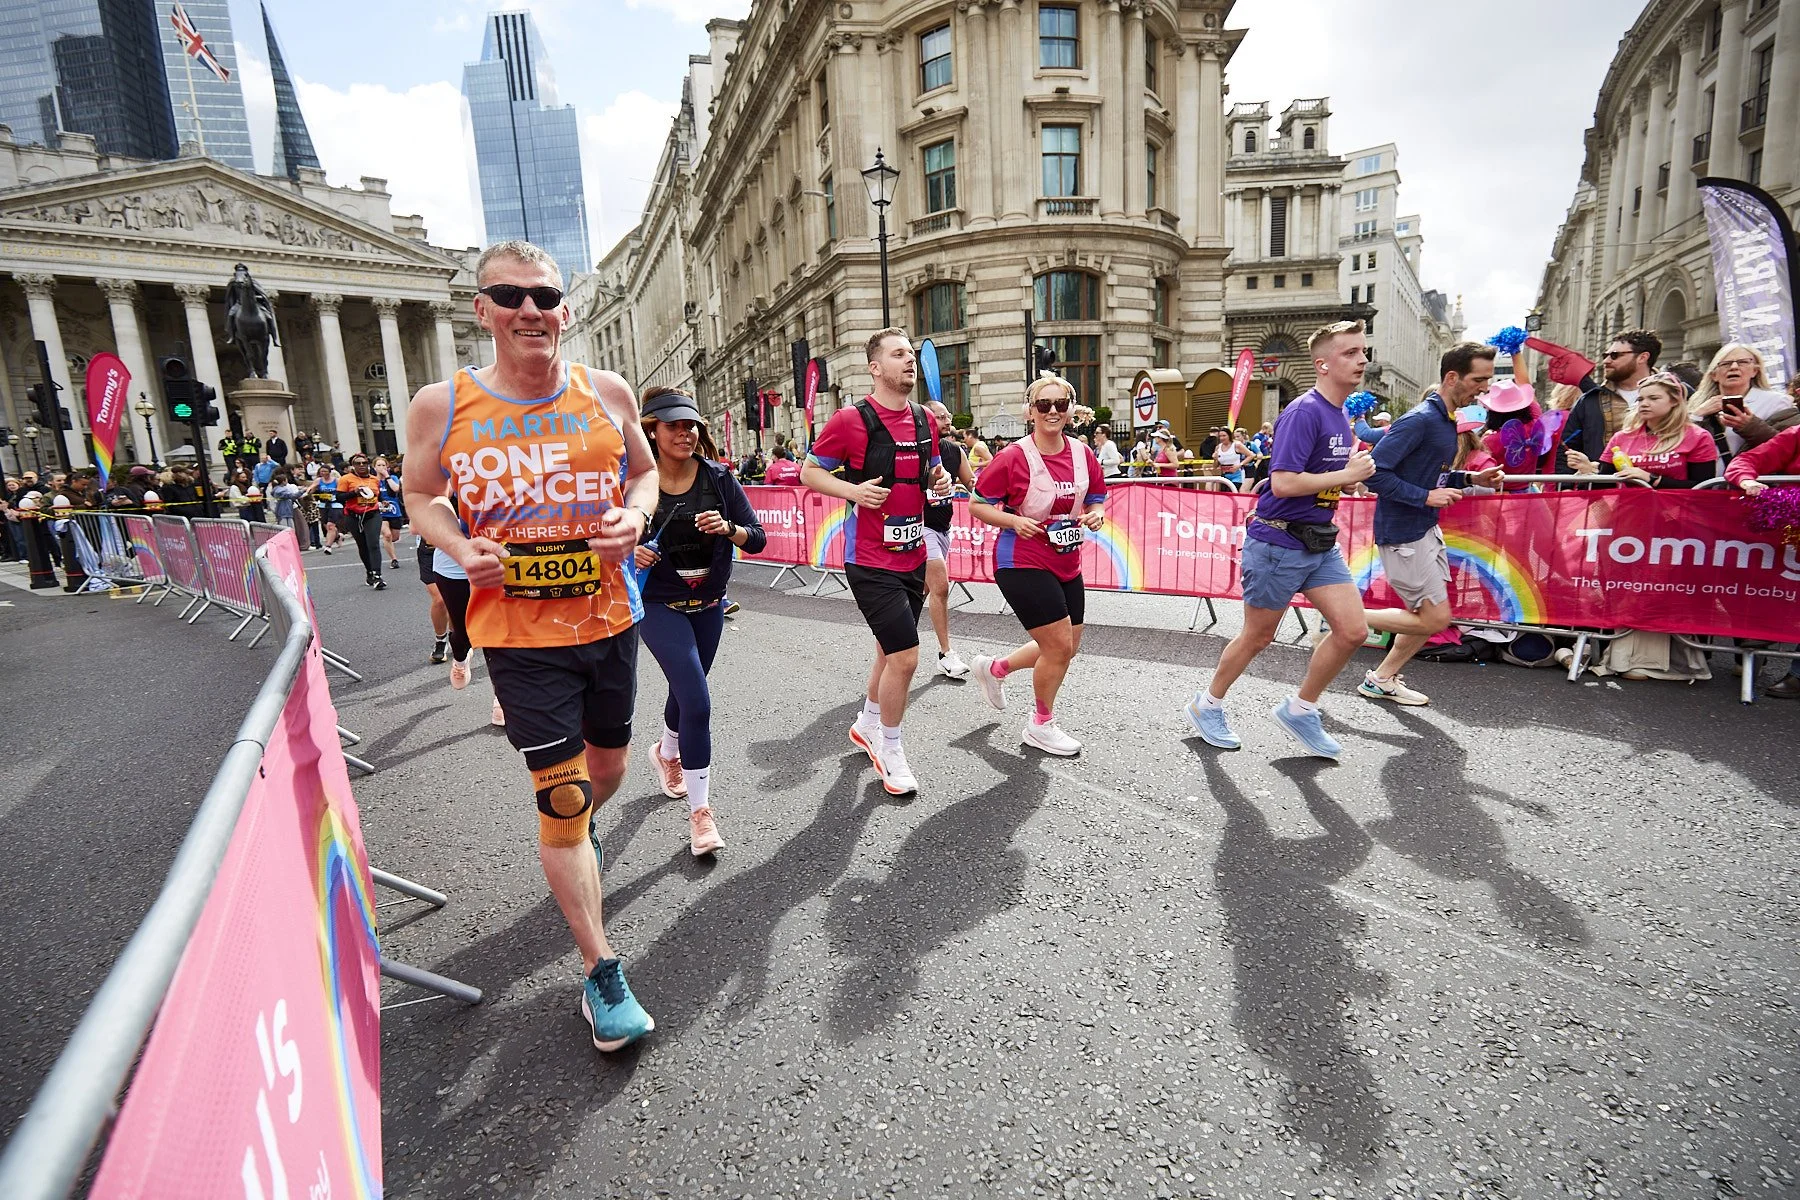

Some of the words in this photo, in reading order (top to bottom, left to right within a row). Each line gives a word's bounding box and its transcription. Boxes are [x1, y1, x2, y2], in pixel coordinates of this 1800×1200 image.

[96, 368, 118, 424] Tommy's
[472, 412, 591, 442] MARTIN
[449, 442, 571, 484] BONE
[459, 471, 616, 511] CANCER
[568, 500, 612, 517] TRUS
[753, 505, 804, 529] mmy's
[506, 525, 570, 539] THERE'S
[575, 524, 585, 535] A
[949, 524, 1000, 546] my's
[1055, 529, 1080, 544] 9186
[1157, 512, 1247, 545] Tomm
[536, 544, 565, 553] RUSHY
[1157, 547, 1173, 556] The
[1175, 551, 1226, 562] pregnancy
[1575, 528, 1800, 582] Tommy
[509, 557, 595, 581] 14804
[1571, 576, 1600, 589] The
[1606, 578, 1696, 595] pregnancy
[1702, 583, 1738, 595] and
[1745, 584, 1797, 601] baby
